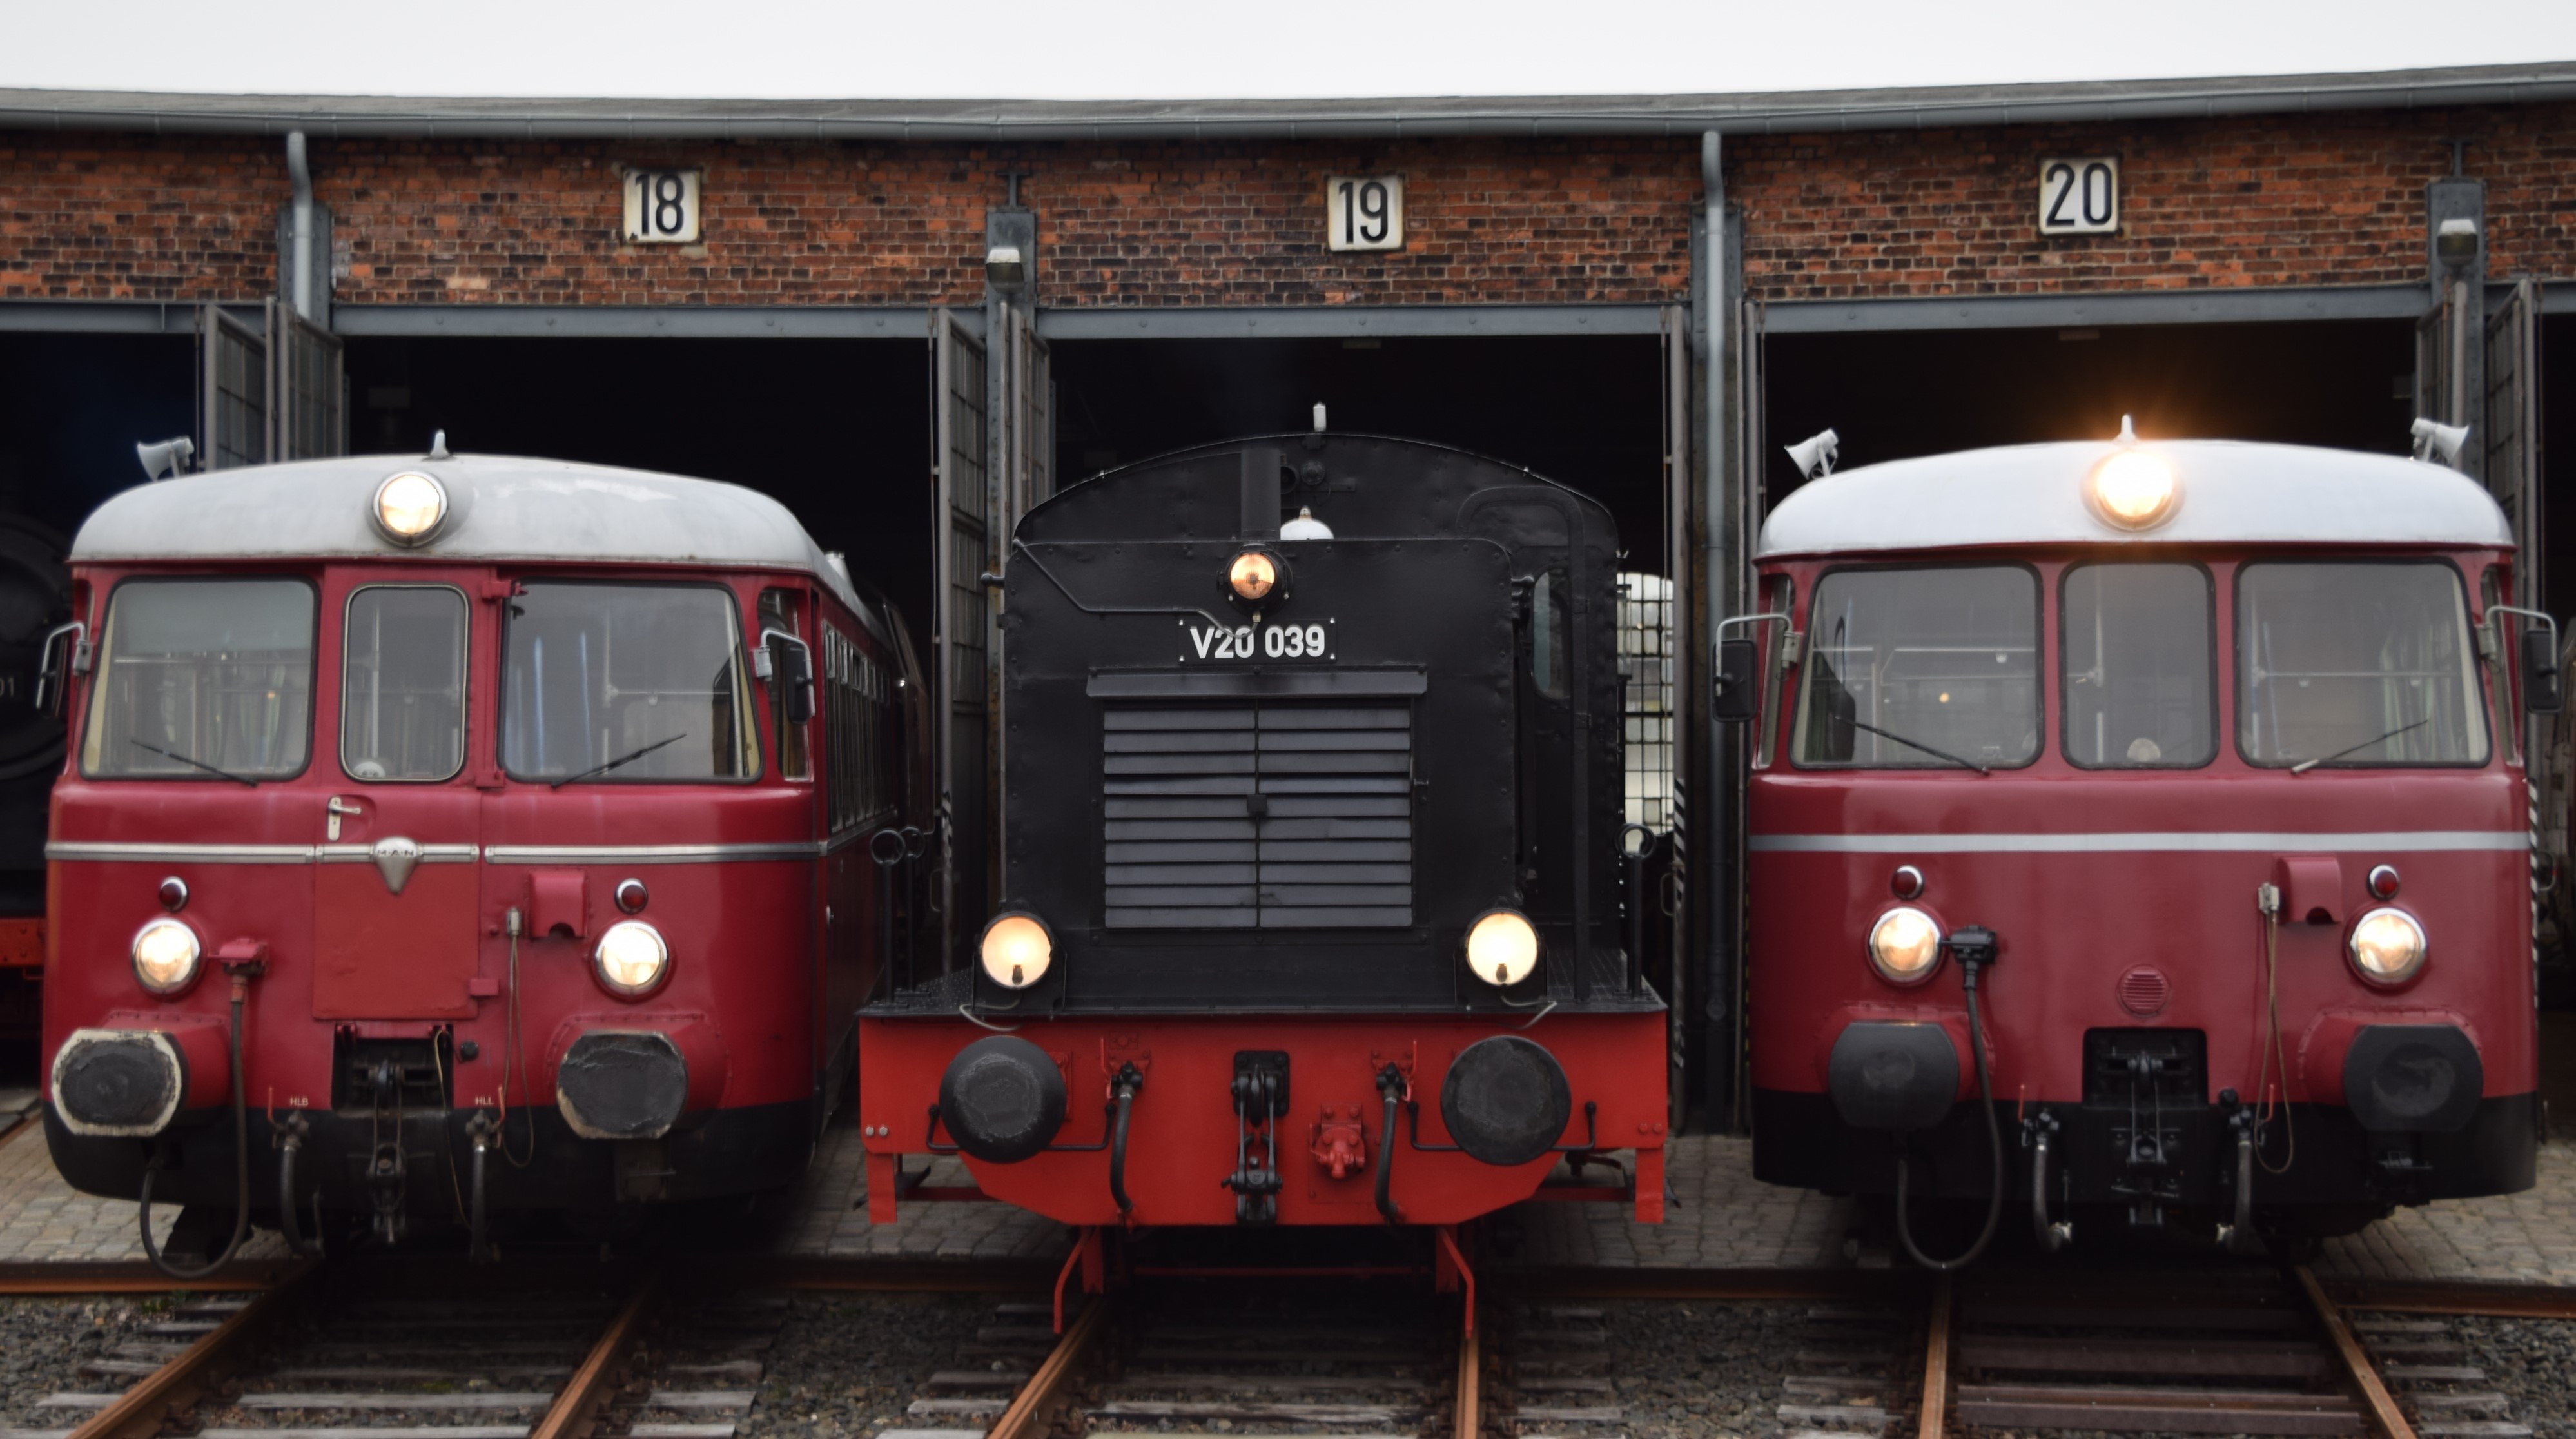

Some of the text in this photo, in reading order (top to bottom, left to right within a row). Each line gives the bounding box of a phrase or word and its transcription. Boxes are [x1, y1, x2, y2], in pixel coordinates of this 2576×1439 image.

[636, 173, 684, 236] 18
[1339, 181, 1388, 244] 19
[2045, 163, 2112, 226] 20
[1190, 624, 1325, 659] V20 039
[289, 1097, 309, 1106] HLB
[475, 1096, 494, 1106] HLL
